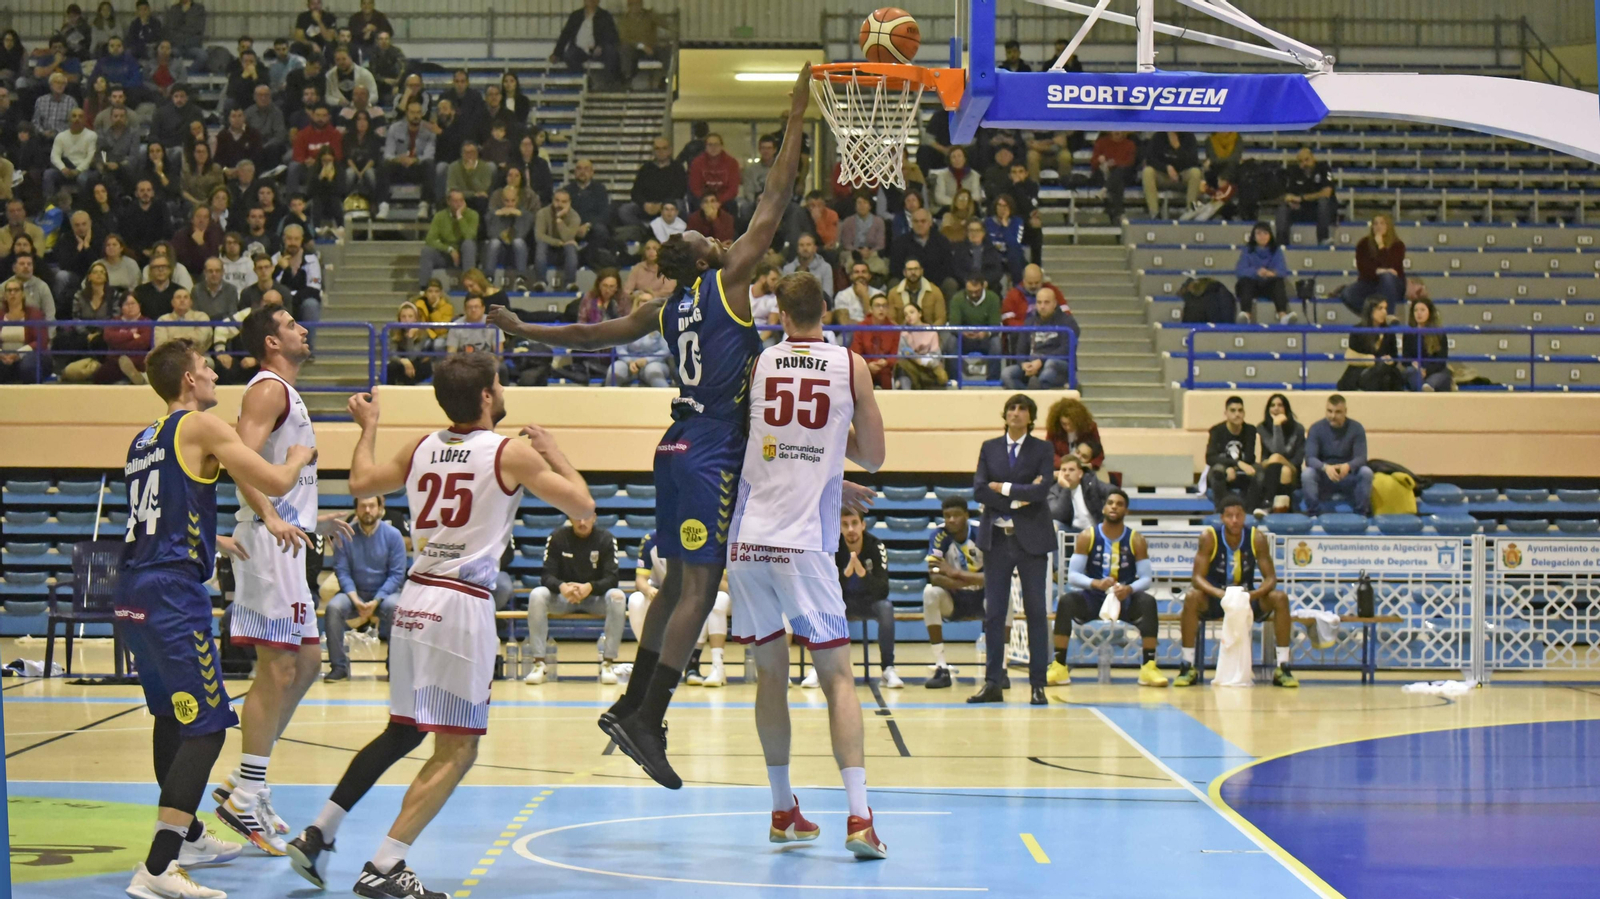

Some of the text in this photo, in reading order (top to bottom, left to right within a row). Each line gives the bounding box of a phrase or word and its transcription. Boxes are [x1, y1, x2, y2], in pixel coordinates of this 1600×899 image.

[1047, 84, 1229, 108] SPORT SYSTEM
[763, 377, 831, 430] 55
[778, 443, 825, 454] Comunidad
[430, 446, 472, 464] J. LÓPEZ
[778, 451, 789, 459] de
[800, 453, 821, 463] Rioja
[415, 472, 475, 530] 25
[1317, 541, 1432, 553] Ayuntamiento de Algeciras
[1527, 544, 1588, 554] Ayuntamiento
[739, 553, 751, 562] de
[1321, 556, 1428, 567] Delegación de Deportes
[1531, 558, 1580, 568] Delegación
[1583, 558, 1594, 566] de
[290, 602, 307, 626] 15
